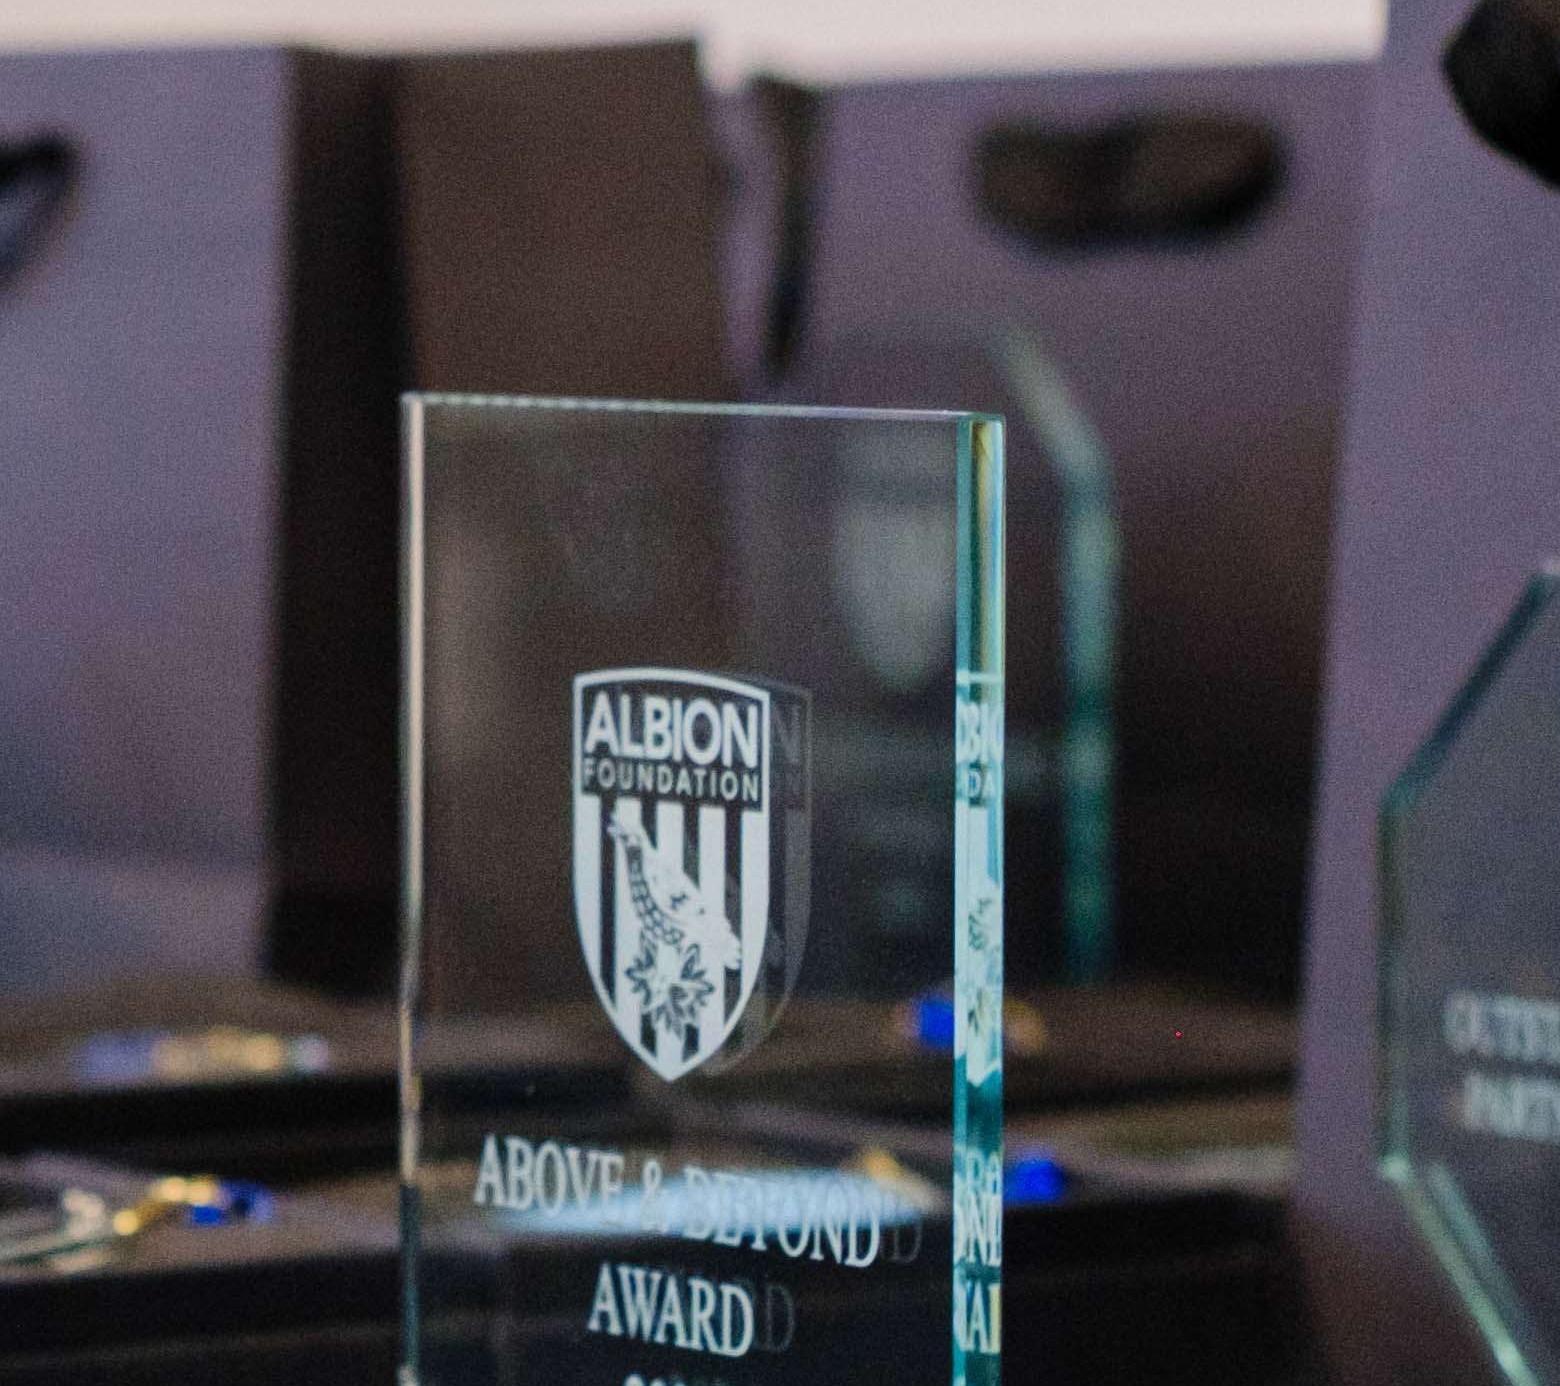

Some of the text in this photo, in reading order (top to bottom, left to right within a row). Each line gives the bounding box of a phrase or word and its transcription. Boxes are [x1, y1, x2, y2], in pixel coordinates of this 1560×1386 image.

[584, 689, 759, 769] ALBION
[583, 757, 759, 803] FOUNDATION
[473, 1132, 625, 1225] ABOVE
[641, 1157, 673, 1234] &
[587, 1261, 755, 1358] AWARD
